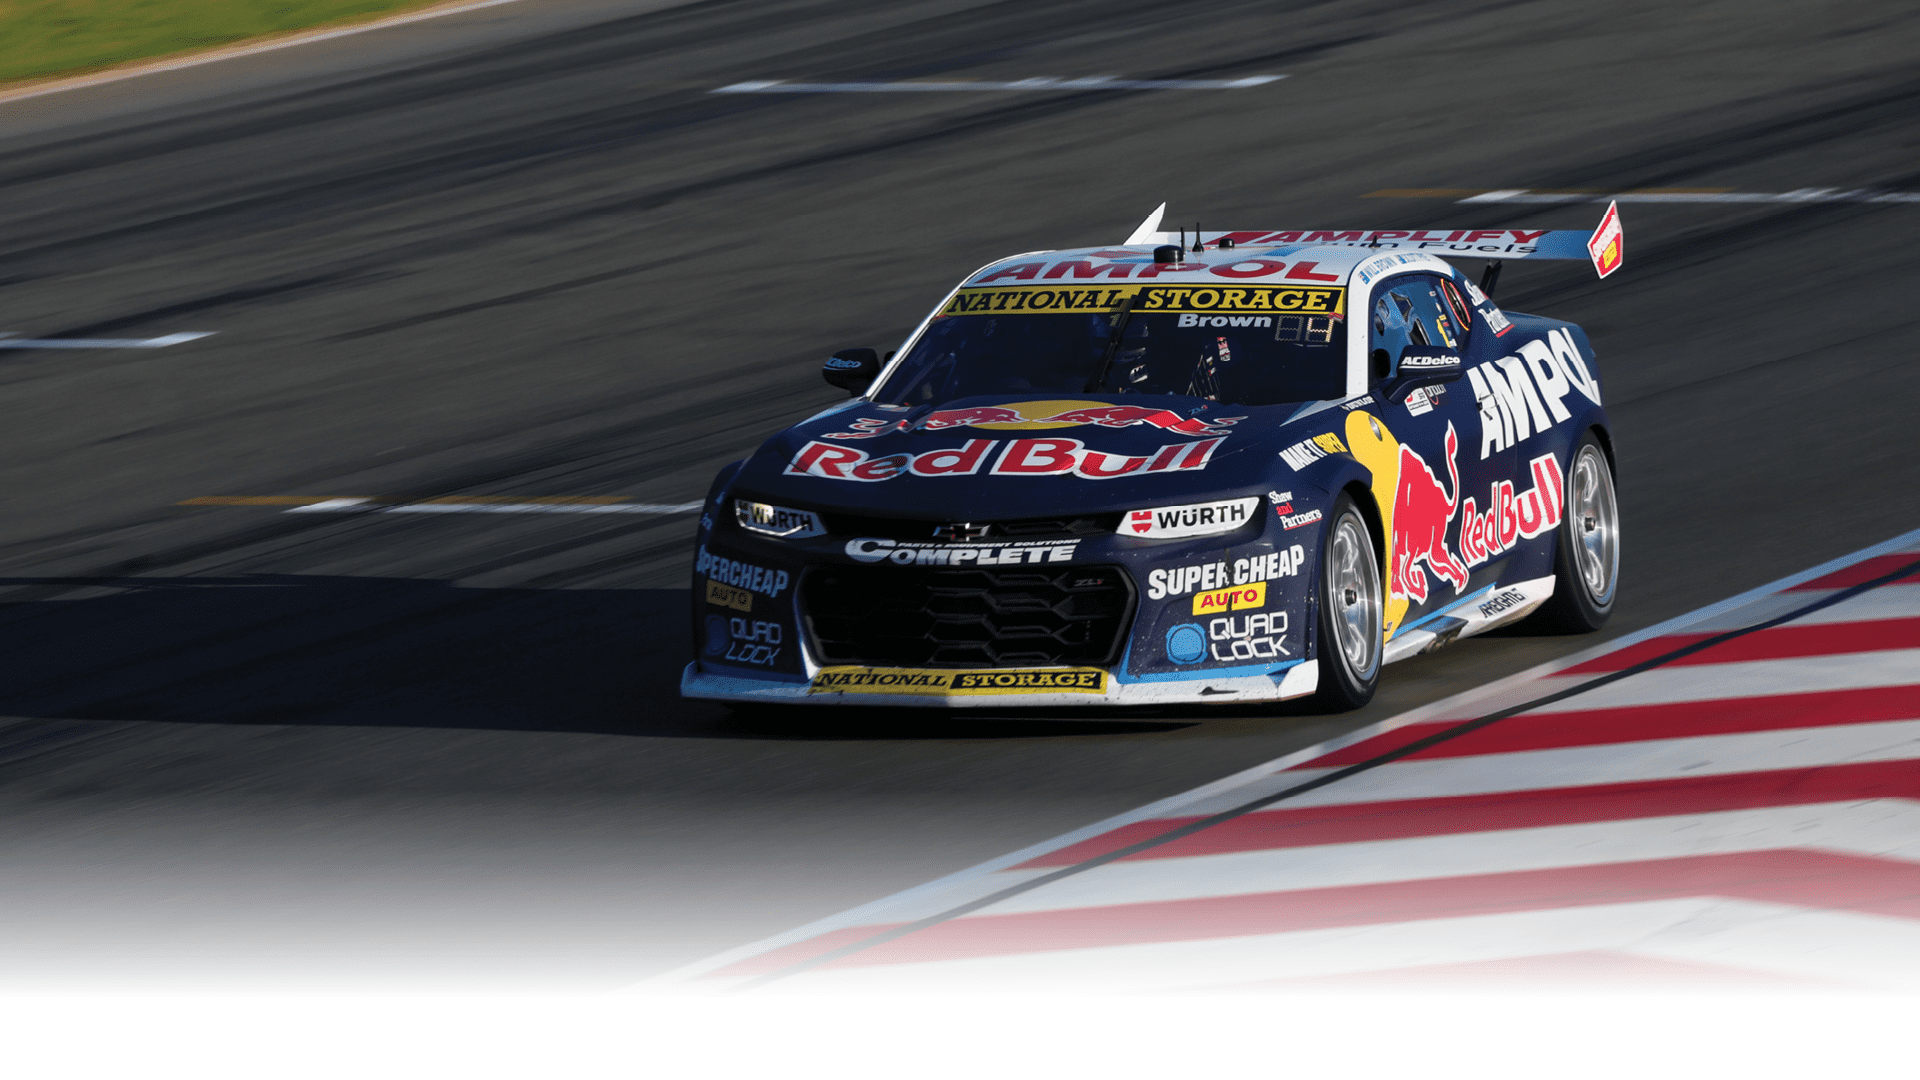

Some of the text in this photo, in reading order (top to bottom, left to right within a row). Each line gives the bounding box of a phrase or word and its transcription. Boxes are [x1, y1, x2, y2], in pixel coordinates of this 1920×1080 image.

[1253, 230, 1544, 244] AMPLIFY
[1418, 241, 1538, 254] Fuels
[974, 259, 1340, 283] AMPOL
[946, 289, 1332, 313] NATIONAL STORAGE
[1177, 314, 1272, 328] Brown
[1401, 355, 1461, 366] ACDelco
[1466, 327, 1602, 461] AMPOL
[783, 436, 1229, 483] Red Bull
[1268, 490, 1293, 505] Shaw
[1157, 503, 1246, 529] WÜRTH
[1276, 501, 1294, 516] and
[1280, 508, 1323, 529] Partners
[845, 537, 1078, 566] COMPLETE
[1200, 589, 1258, 609] AUTO
[1209, 610, 1289, 640] QUAD
[1211, 634, 1291, 662] LOCK
[816, 671, 1096, 688] NATIONAL STORAGE
